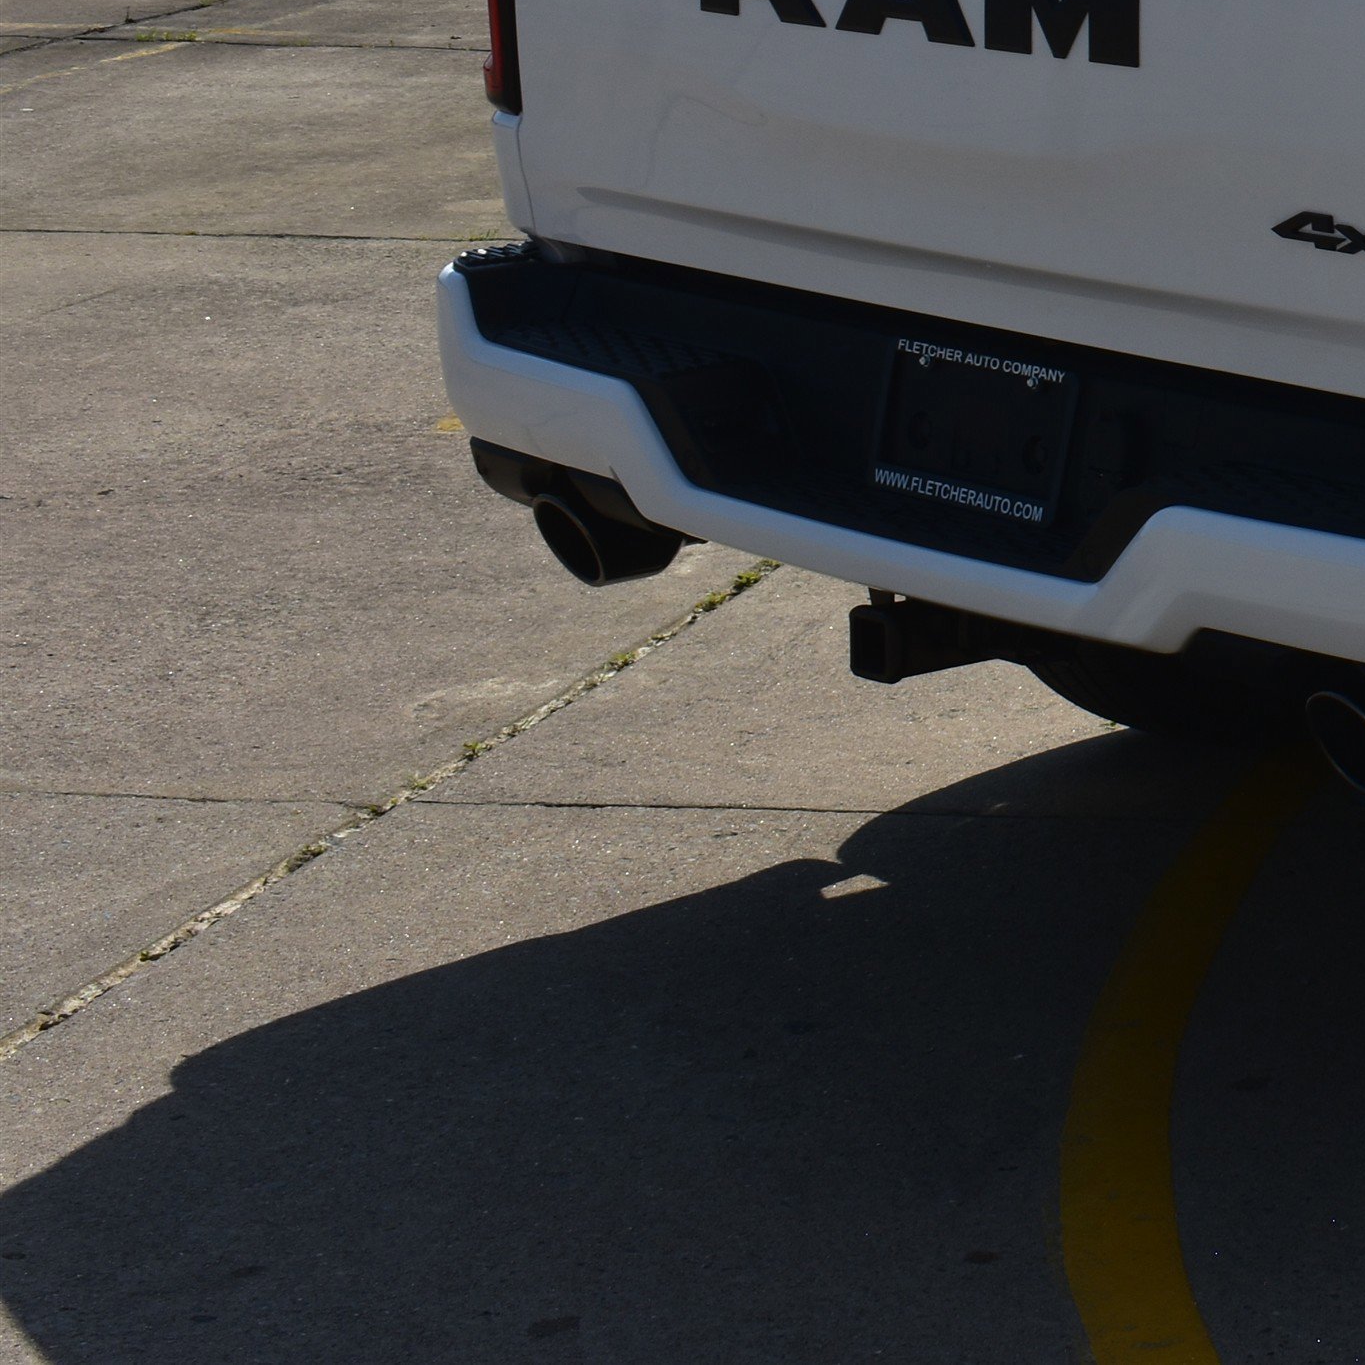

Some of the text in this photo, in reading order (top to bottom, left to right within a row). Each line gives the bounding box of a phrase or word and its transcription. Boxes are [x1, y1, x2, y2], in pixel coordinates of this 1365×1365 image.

[898, 339, 1066, 383] FLETCHER AUTO COMPANY
[874, 468, 1044, 522] WWW.FLETCHERAUTO.COM
